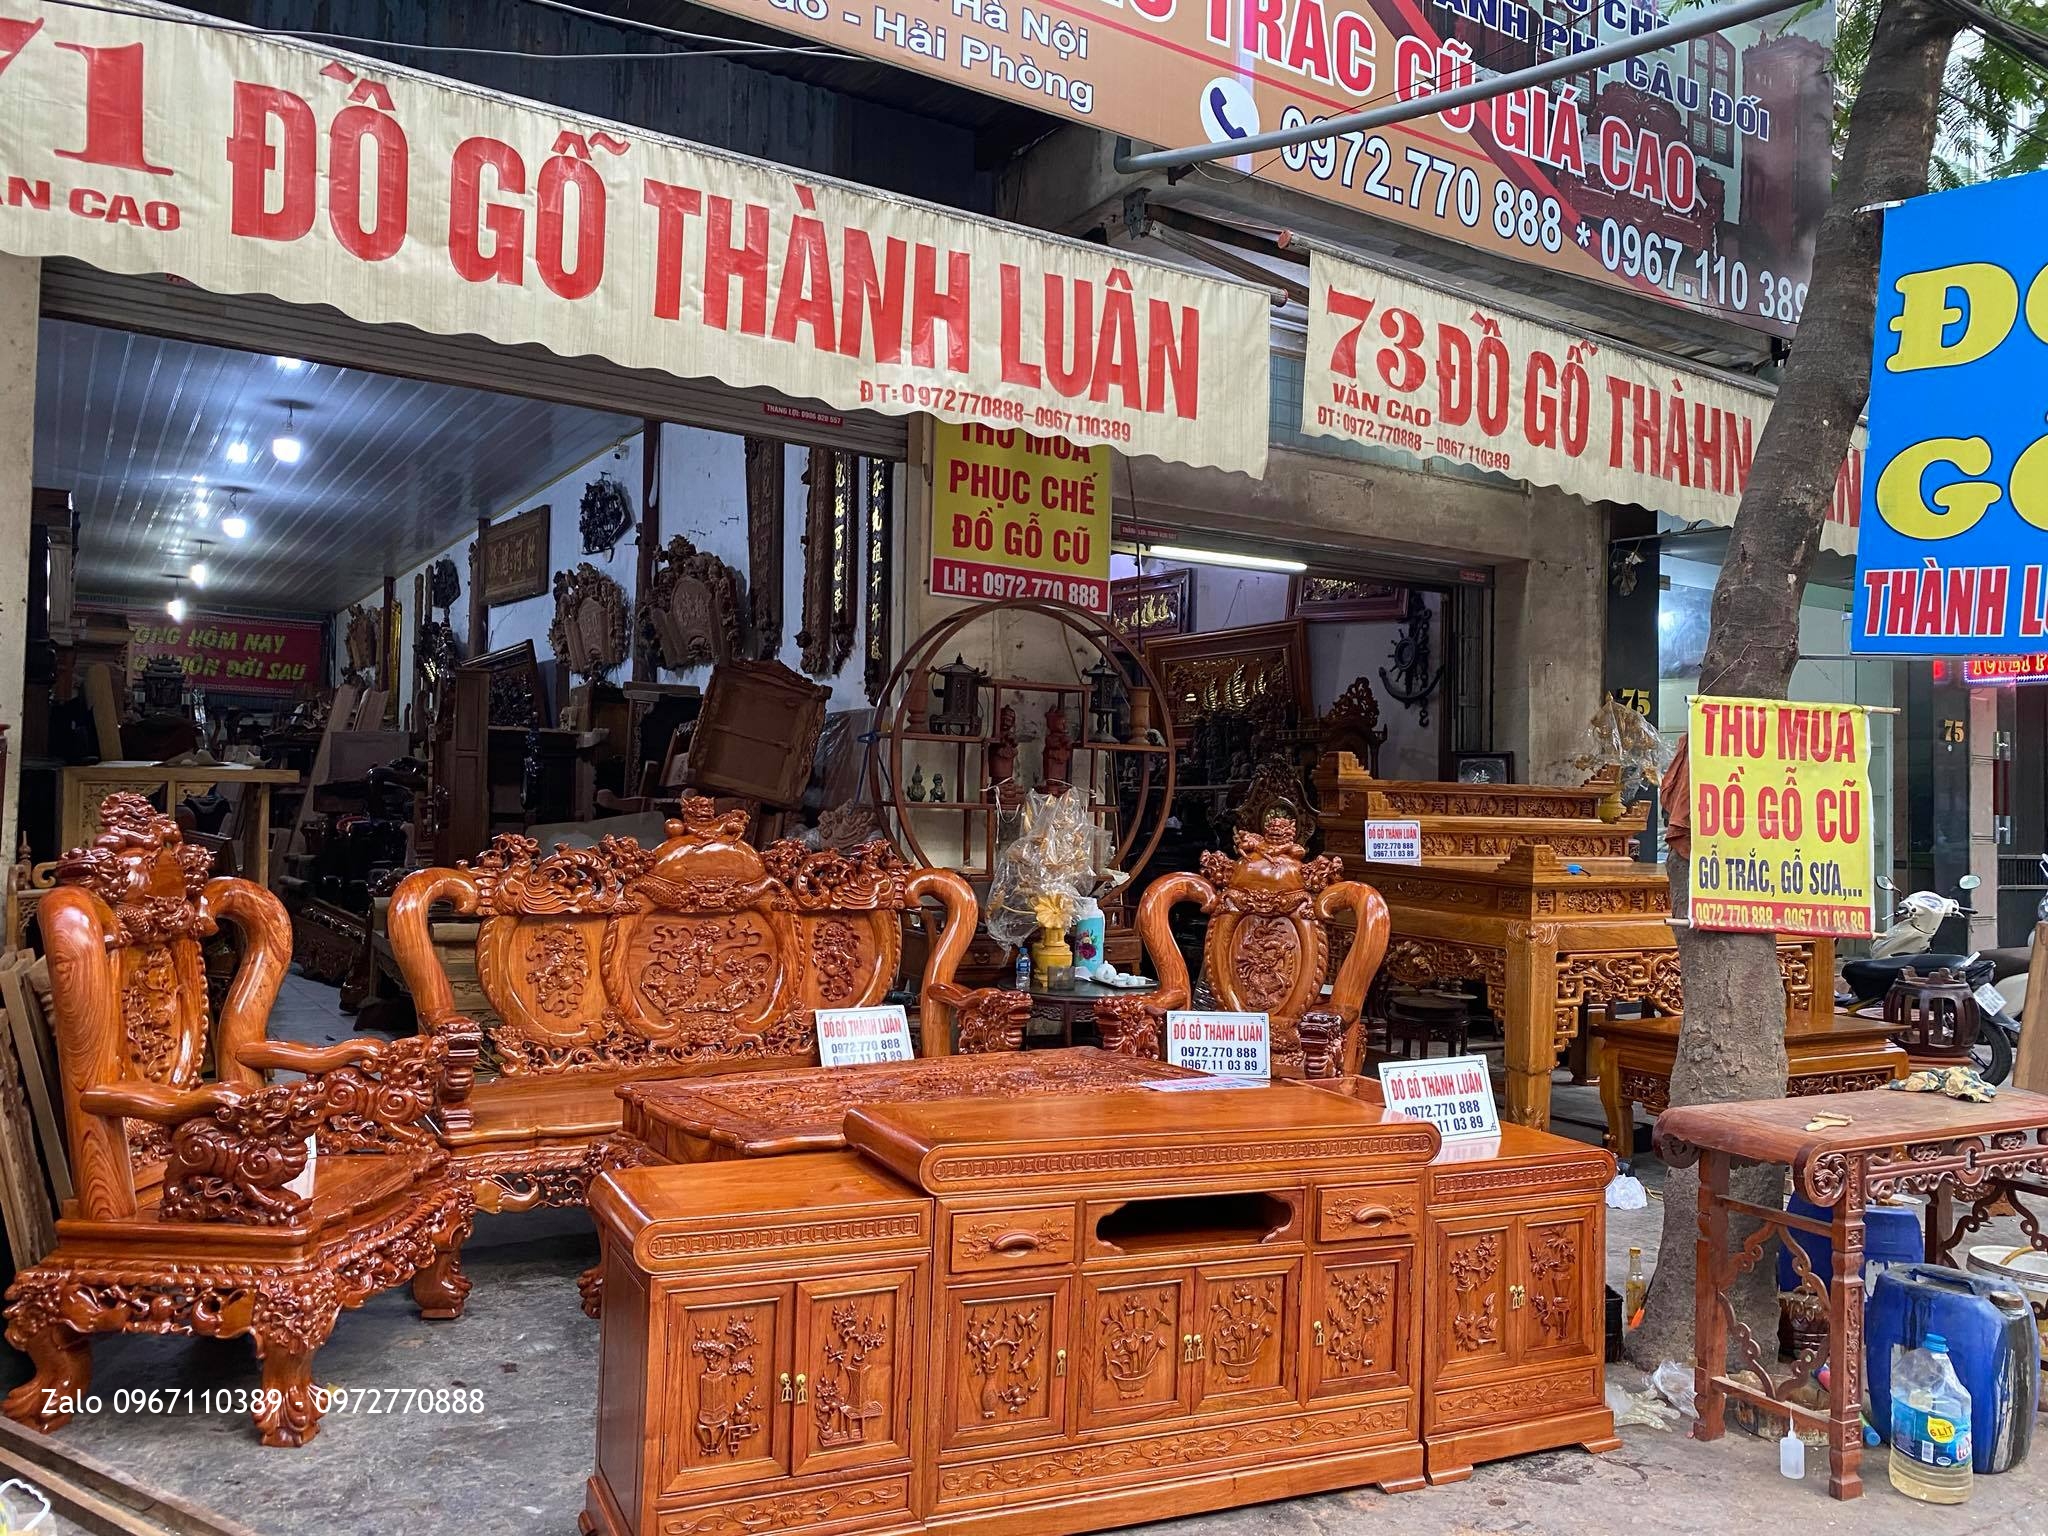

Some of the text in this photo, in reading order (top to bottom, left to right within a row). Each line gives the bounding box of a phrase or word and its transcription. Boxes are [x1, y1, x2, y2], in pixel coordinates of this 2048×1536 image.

[874, 6, 946, 60] Hải
[960, 35, 1093, 113] Phòng
[1021, 8, 1087, 60] Nội
[1393, 35, 1476, 134] CŨ
[1491, 83, 1588, 178] GIÁ
[1600, 115, 1697, 214] CAO
[1623, 56, 1700, 112] CÂU
[1709, 87, 1771, 142] ĐỐI
[0, 176, 181, 231] N CAO
[1280, 105, 1809, 325] 0972.770 888 0967.110 389
[227, 61, 409, 262] ĐỒ
[448, 130, 631, 300] GỖ
[643, 178, 971, 374] THÀNH
[1000, 265, 1200, 421] LUÂN
[1885, 262, 2048, 374] Đ
[1327, 284, 1428, 393] 73
[1436, 311, 1511, 437] ĐỒ
[1523, 341, 1599, 458] GỖ
[1332, 383, 1432, 427] VĂN CAO
[949, 458, 1098, 516] PHỤC CHẾ
[952, 506, 1091, 566] ĐỒ GỖ CŨ
[982, 570, 1063, 600] 0972.770
[1068, 583, 1099, 608] 888
[1863, 557, 2048, 637] THÀNH L
[244, 633, 286, 654] NAY
[267, 662, 307, 681] SAU
[1622, 688, 1651, 716] 75
[1701, 703, 1856, 763] THU MUA
[1944, 719, 1965, 743] 75
[1698, 766, 1860, 844] ĐỒ GỖ CŨ
[1699, 844, 1719, 890] GỖ
[1780, 849, 1803, 895] GỖ
[879, 1014, 902, 1034] LUÂN
[881, 1038, 900, 1050] 888
[1173, 1018, 1263, 1042] ĐỒ GỖ THÀNH LUÂN
[1181, 1047, 1257, 1058] 0972.770 888
[1181, 1060, 1258, 1071] 0967.11 03 89
[1390, 1068, 1483, 1100] ĐỒ GỖ THÀNH LUÂN
[1404, 1099, 1480, 1119] 0972.770 888
[1453, 1117, 1468, 1131] 03
[1471, 1115, 1484, 1129] 89
